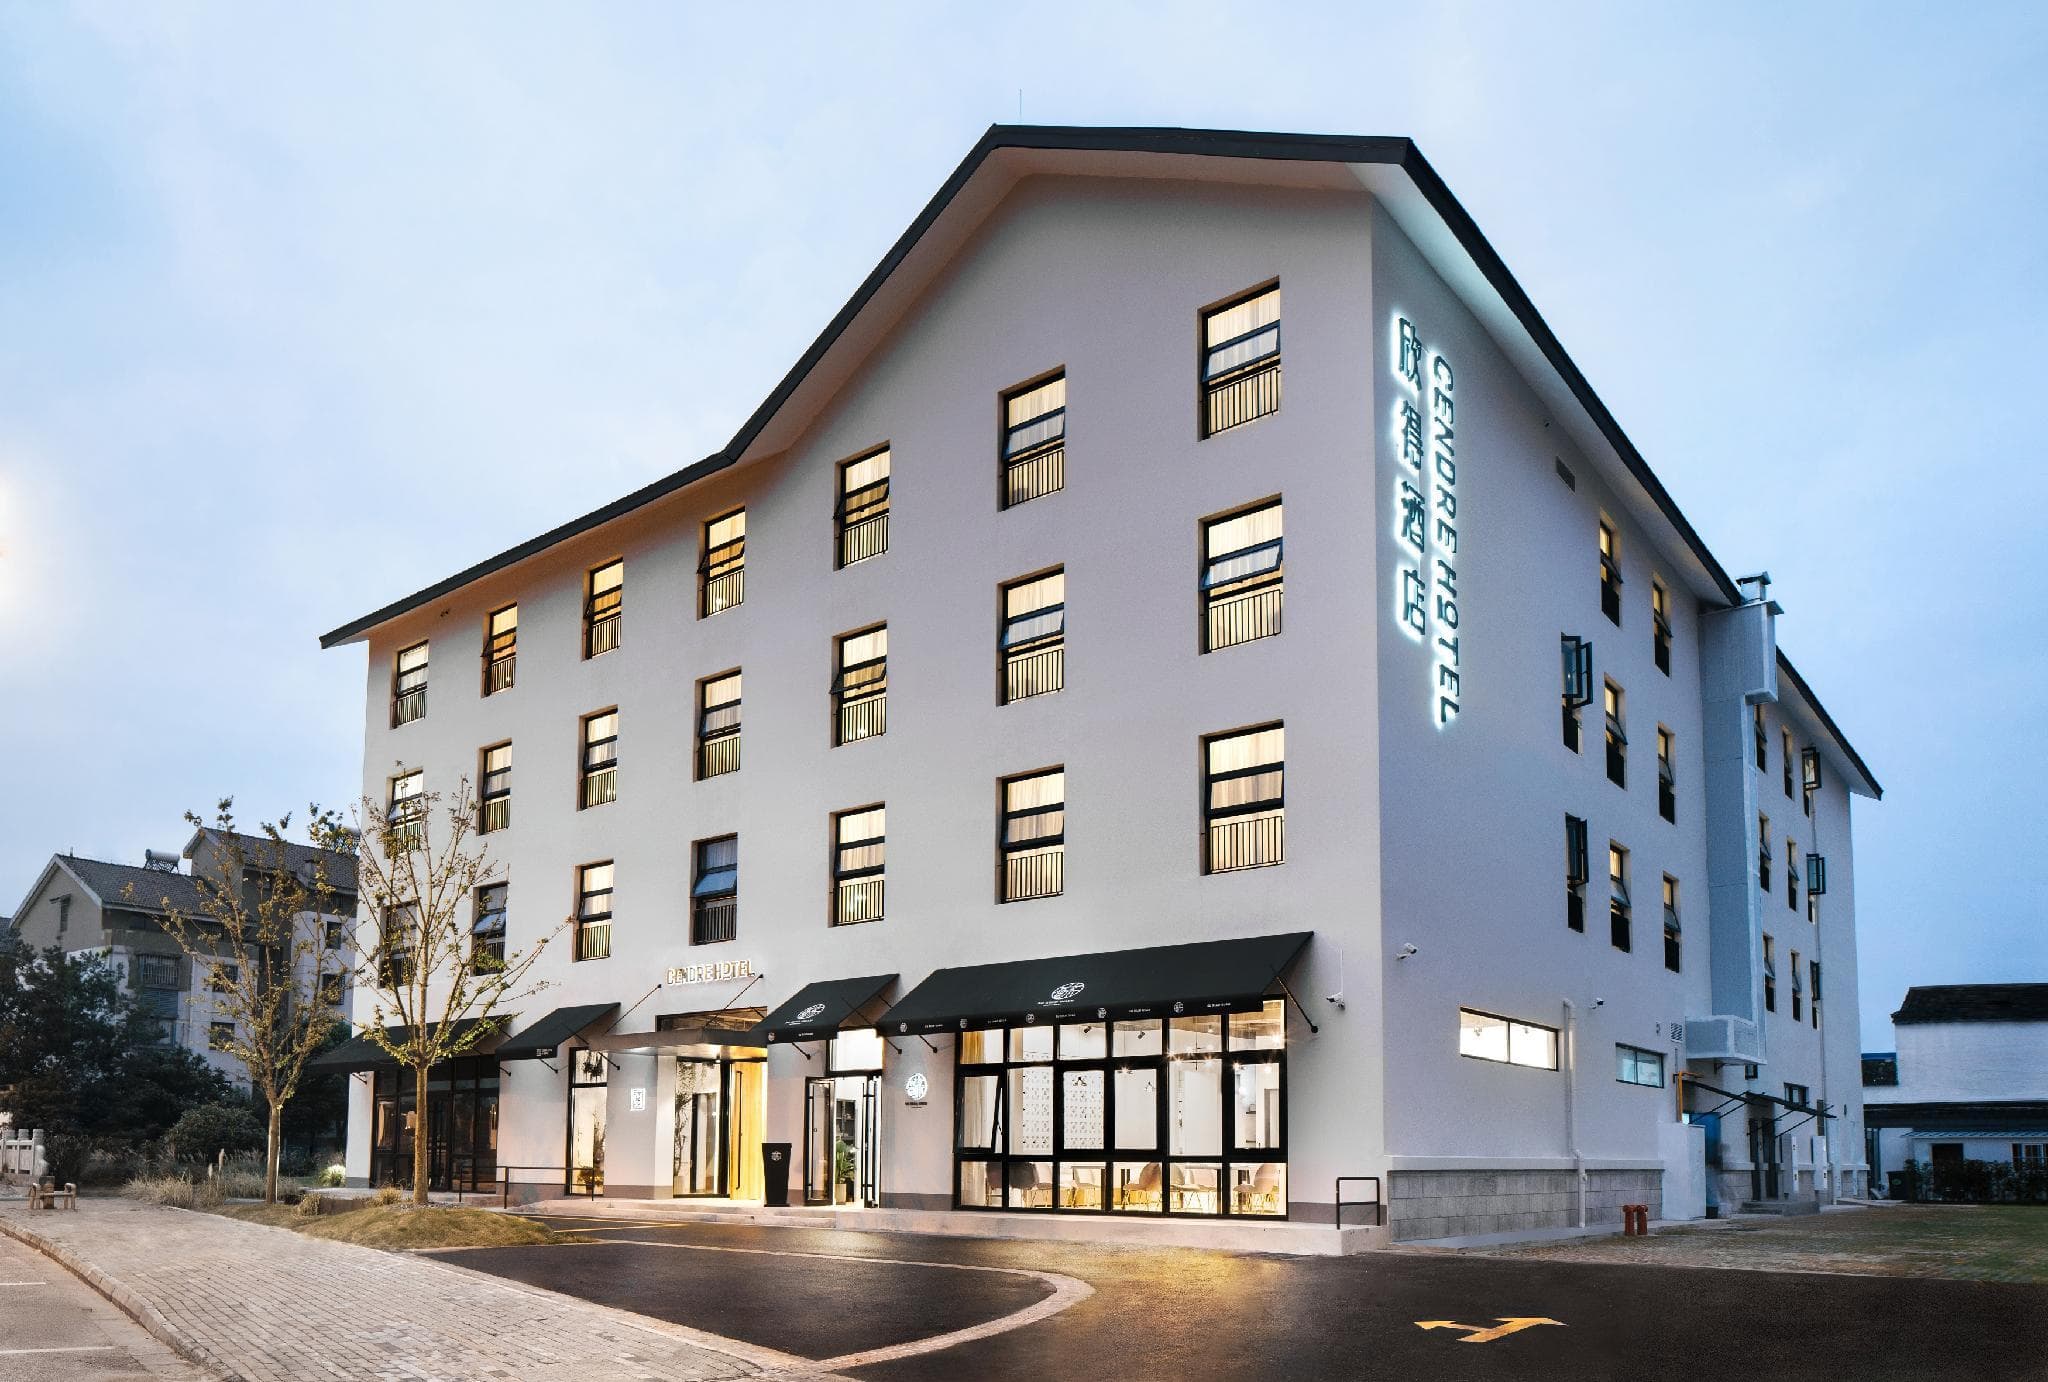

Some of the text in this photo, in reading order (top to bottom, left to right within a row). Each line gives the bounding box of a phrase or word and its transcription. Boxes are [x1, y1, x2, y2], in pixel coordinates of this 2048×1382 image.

[1398, 317, 1426, 636] 欣得酒店
[1433, 354, 1460, 723] CENDRE HOTEL
[713, 960, 755, 980] HOTEL
